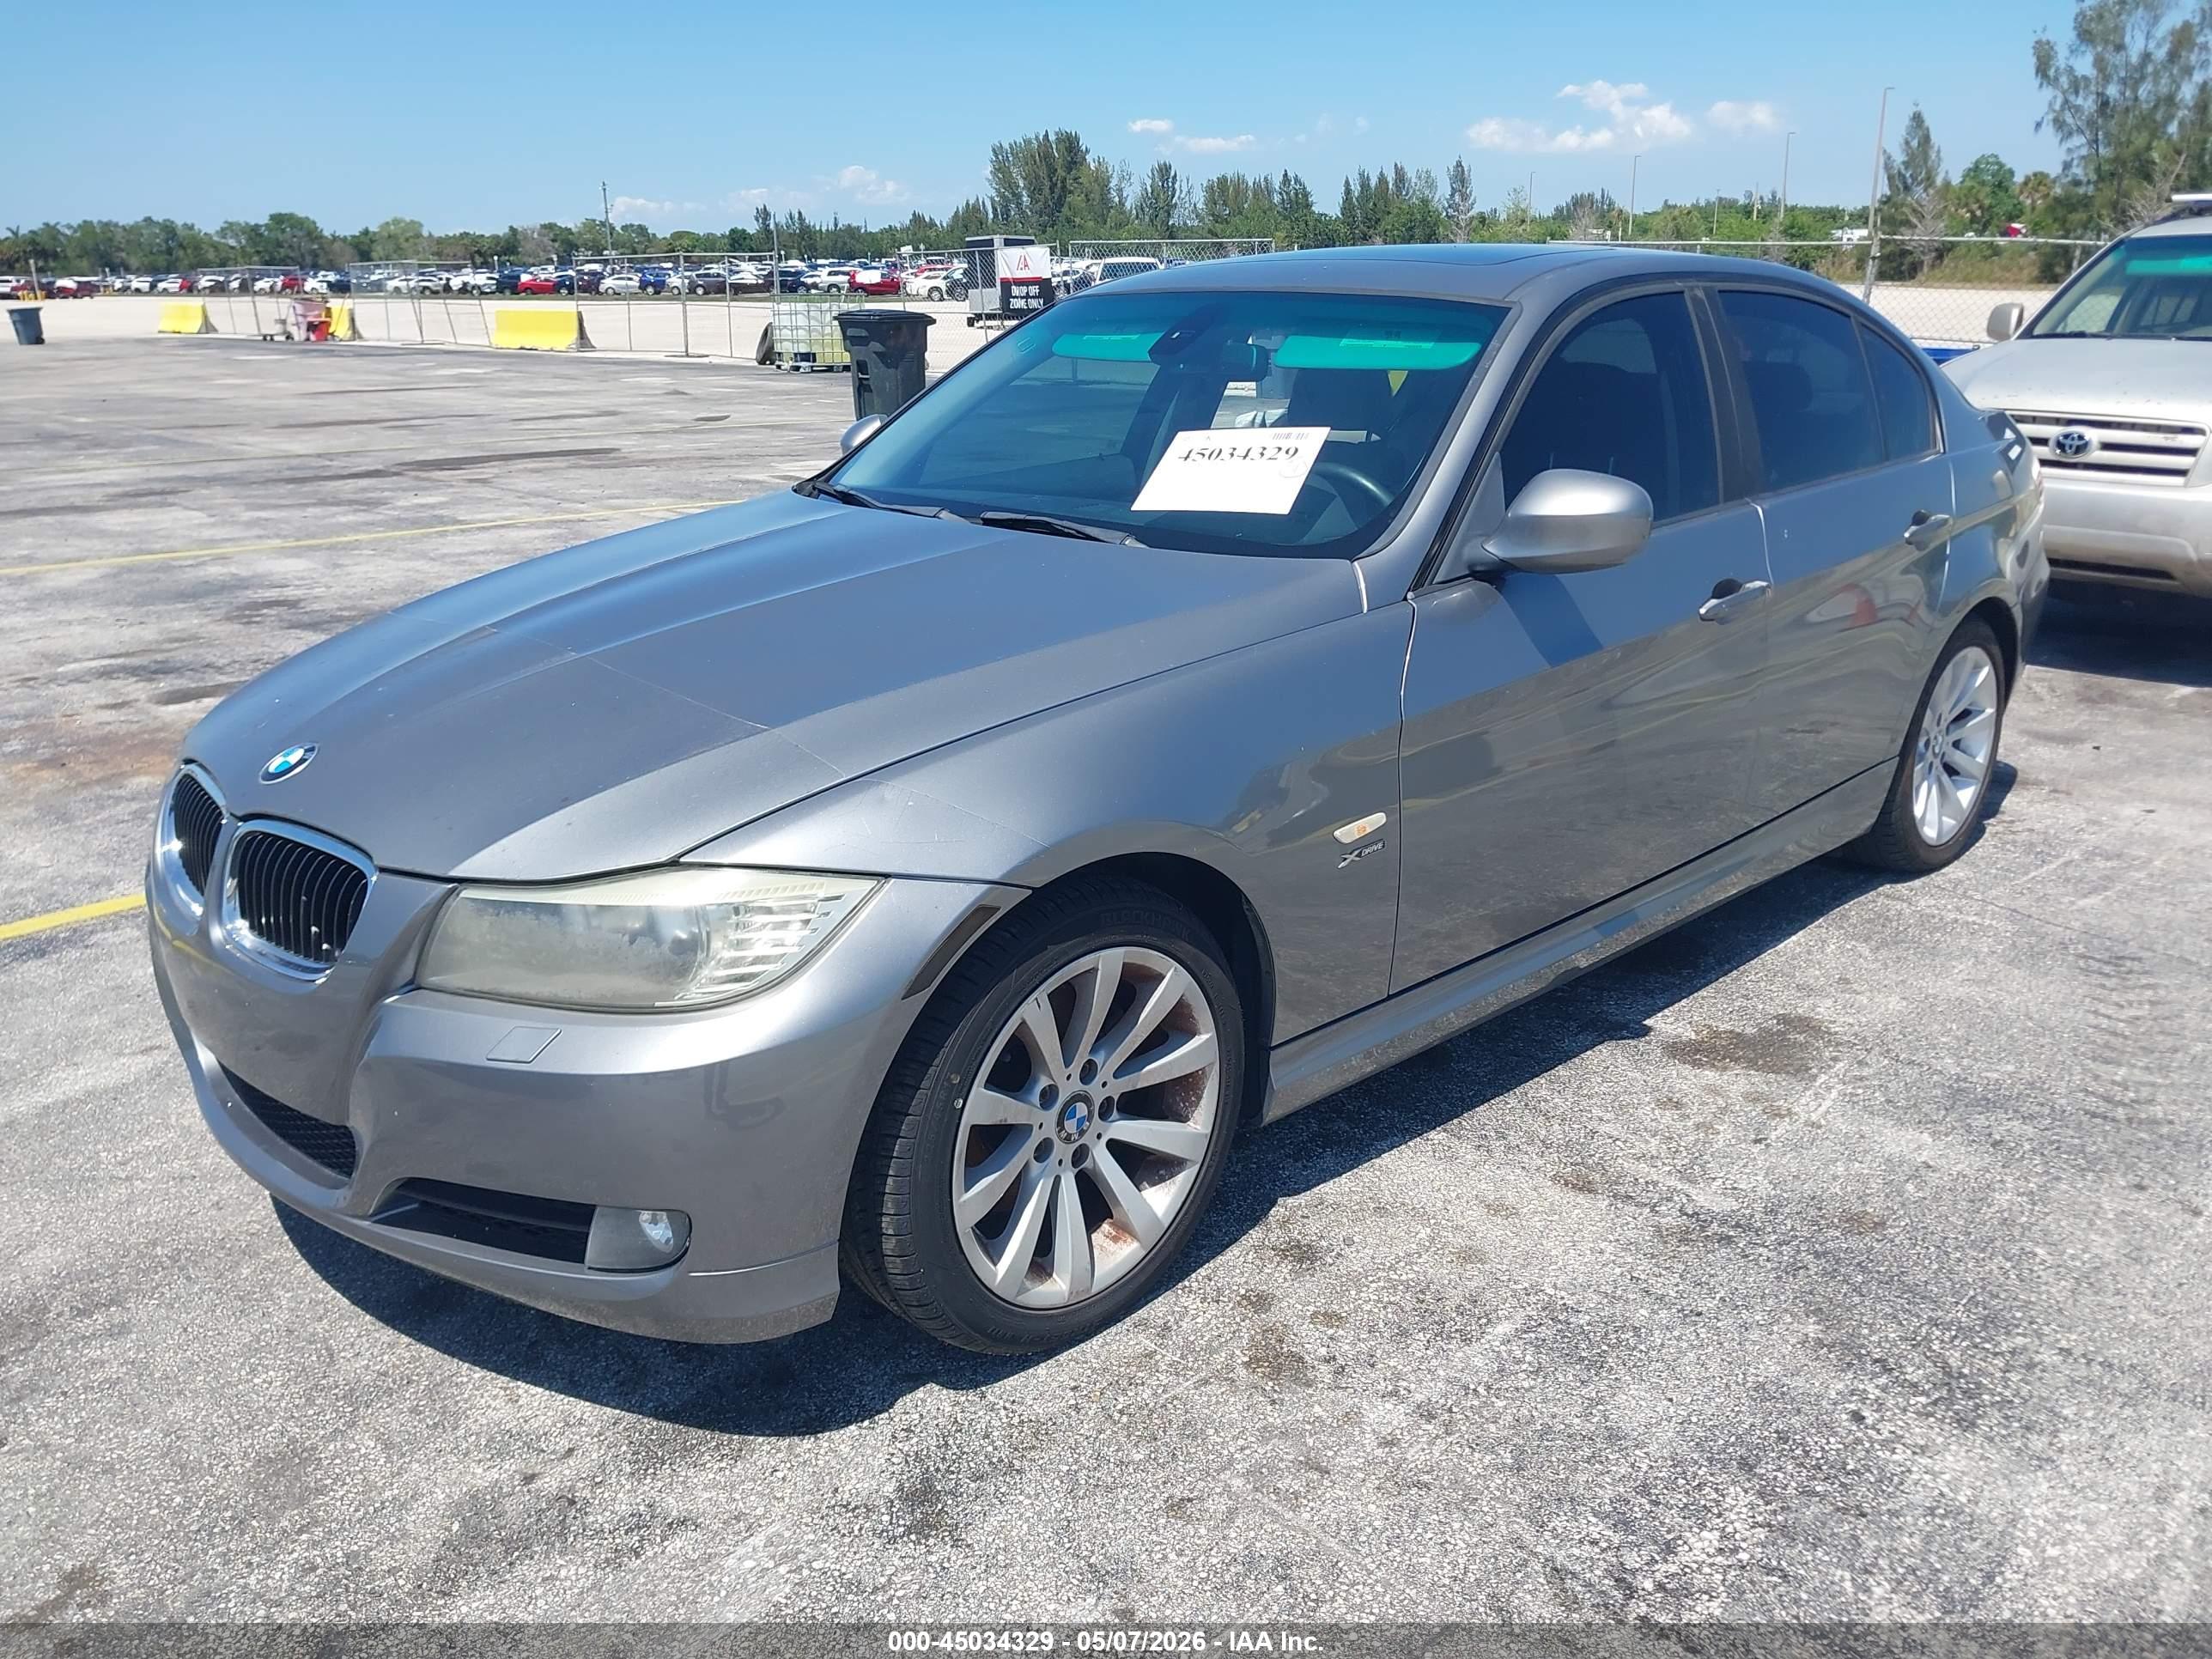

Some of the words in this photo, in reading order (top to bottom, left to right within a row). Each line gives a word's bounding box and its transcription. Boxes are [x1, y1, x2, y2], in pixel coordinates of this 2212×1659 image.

[1028, 286, 1040, 296] OFF
[1009, 298, 1027, 309] ZONE
[1028, 298, 1044, 309] ONLY
[1177, 446, 1299, 463] 45034329
